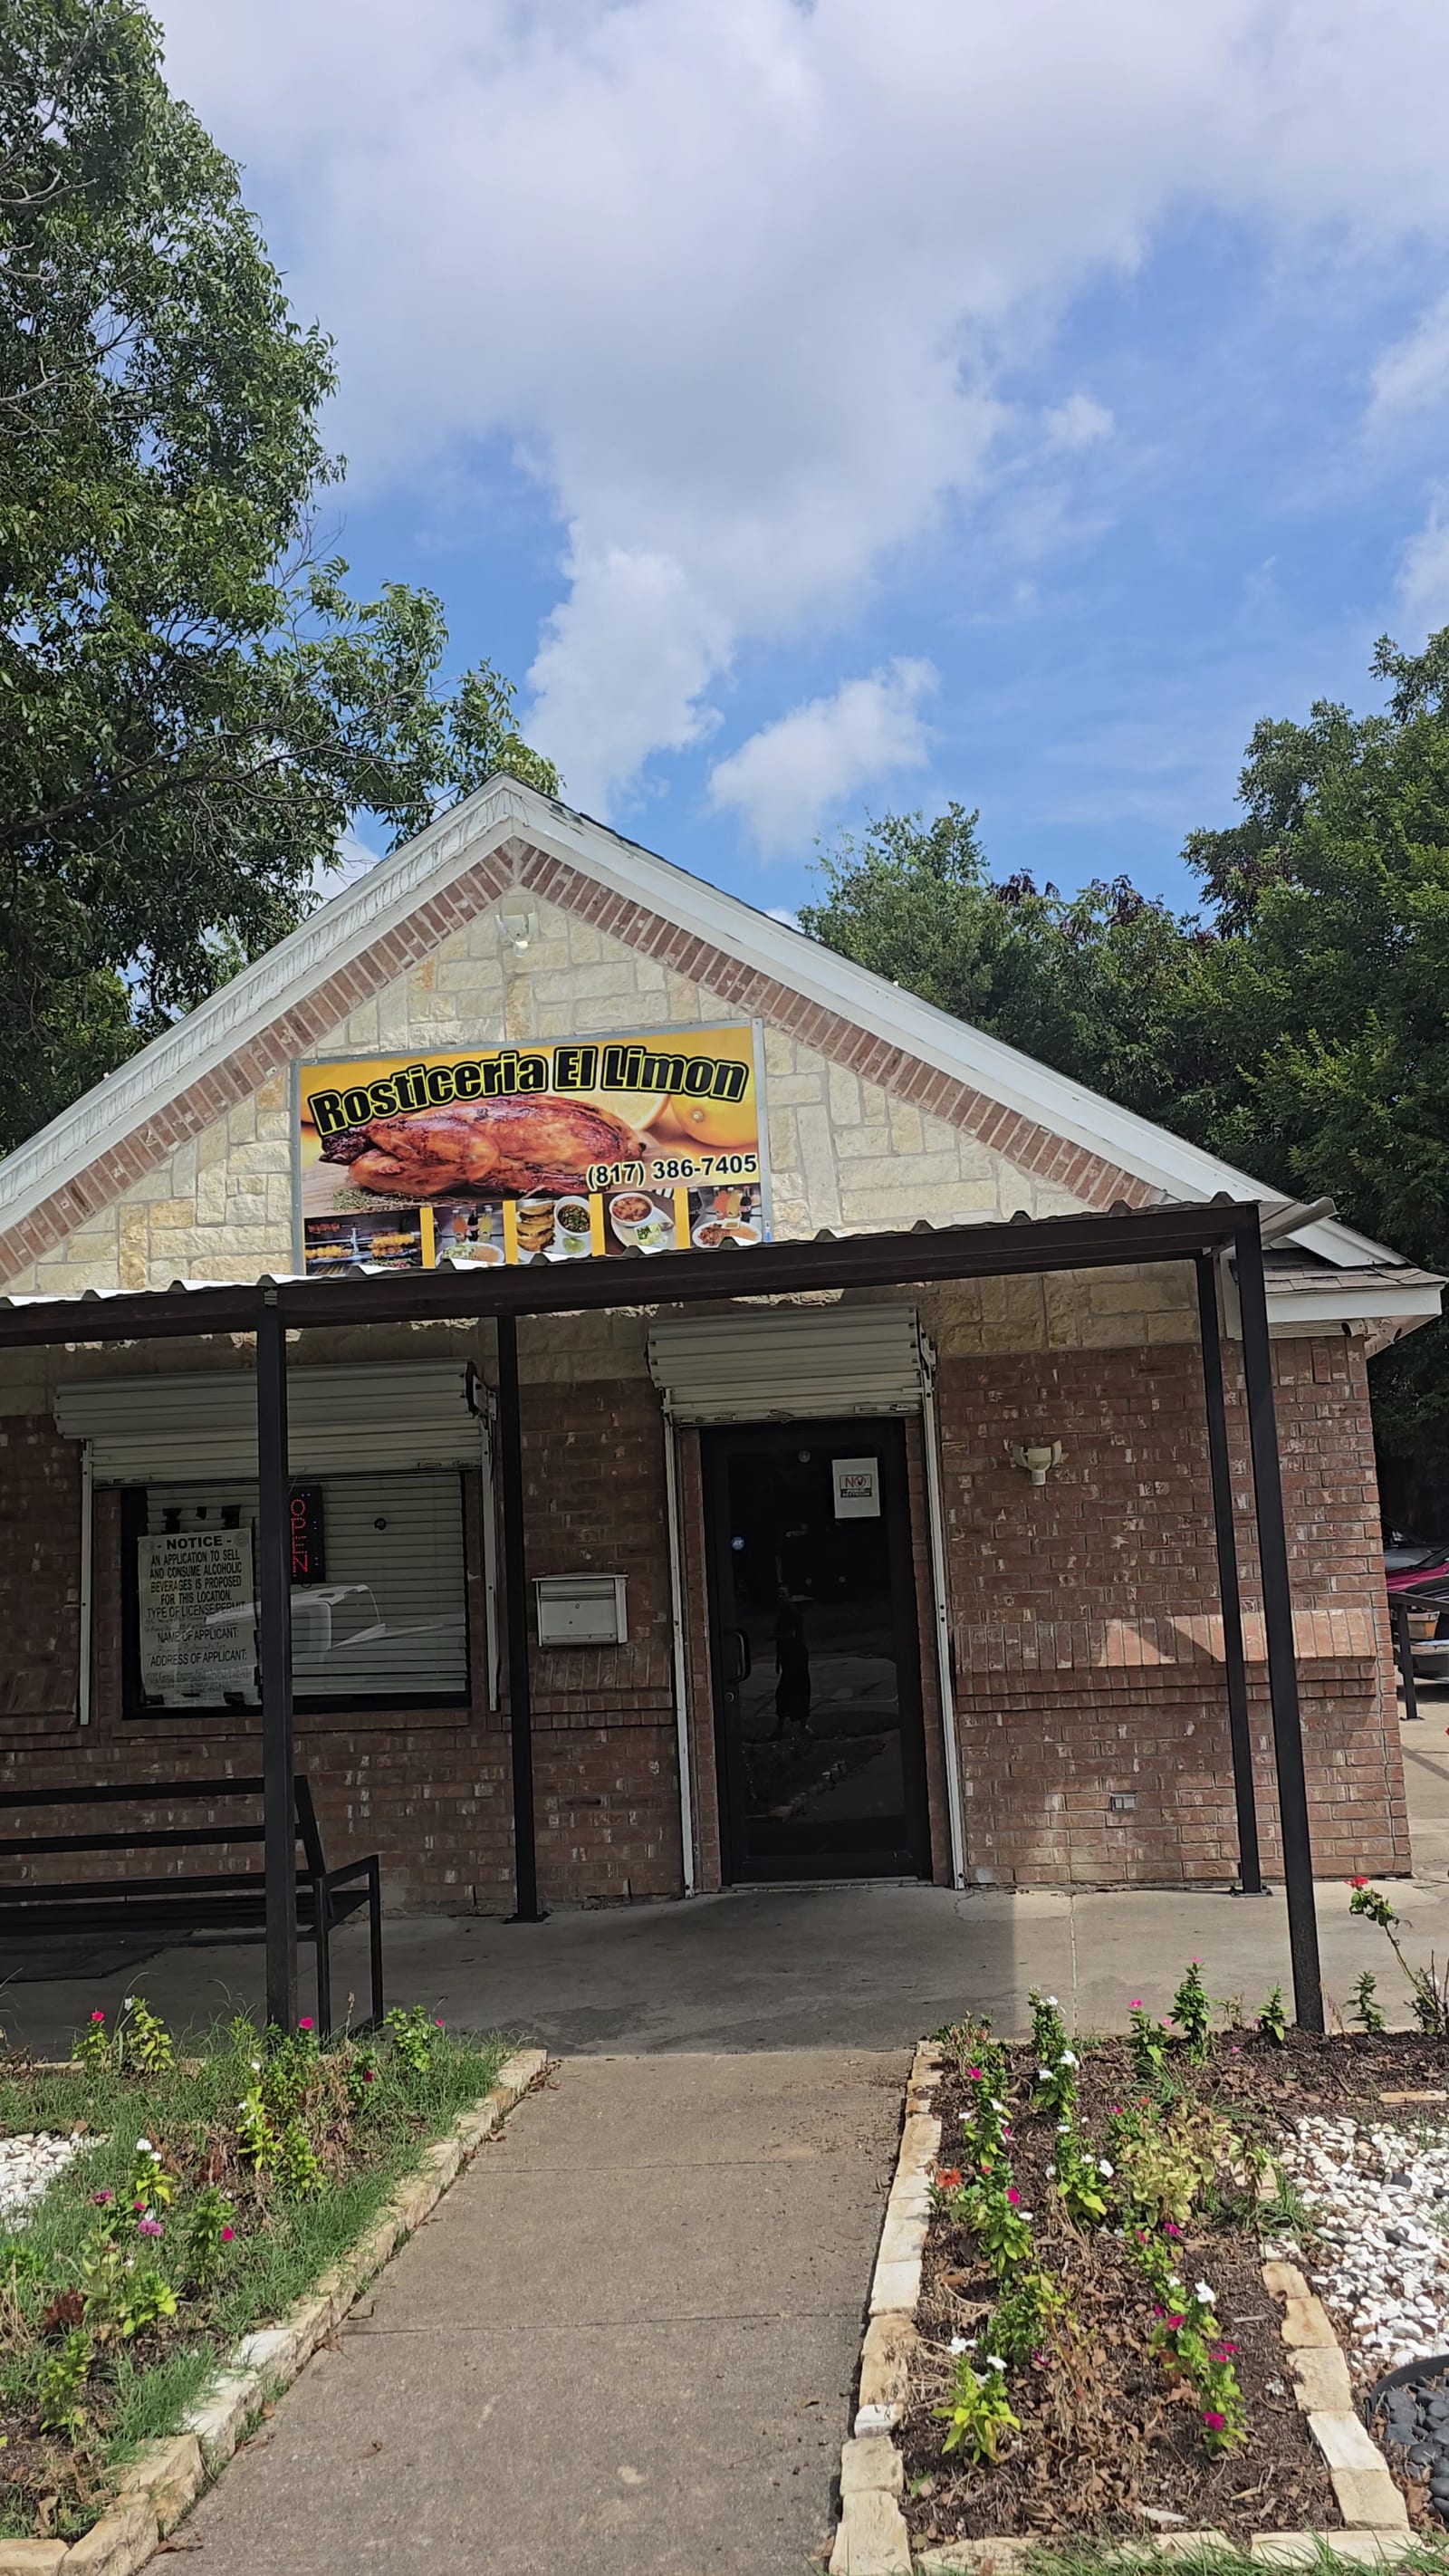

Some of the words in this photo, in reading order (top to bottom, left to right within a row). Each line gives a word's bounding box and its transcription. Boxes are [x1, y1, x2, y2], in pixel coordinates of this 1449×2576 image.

[308, 1052, 549, 1136] Rosticeria
[554, 1046, 599, 1091] El
[602, 1045, 749, 1102] Limon
[587, 1161, 645, 1192] (817)
[651, 1155, 757, 1181] 386-7405
[167, 1535, 223, 1550] NOTICE
[290, 1498, 309, 1573] OPEN
[151, 1555, 160, 1567] AN
[163, 1550, 207, 1565] APPLICATION
[210, 1550, 220, 1562] TO
[223, 1549, 240, 1561] SELL
[149, 1568, 164, 1580] AND
[167, 1564, 200, 1578] CONSUME
[204, 1562, 242, 1576] ALCOHOLIC
[150, 1579, 192, 1593] BEVERAGES
[195, 1578, 202, 1591] IS
[205, 1575, 242, 1590] PROPOSED
[160, 1593, 176, 1605] FOR
[178, 1592, 194, 1604] THIS
[147, 1607, 168, 1619] TYPE
[168, 1606, 179, 1618] OF
[157, 1631, 181, 1643] NAME
[182, 1630, 193, 1642] OF
[150, 1653, 189, 1668] ADDRESS
[190, 1652, 201, 1665] OF
